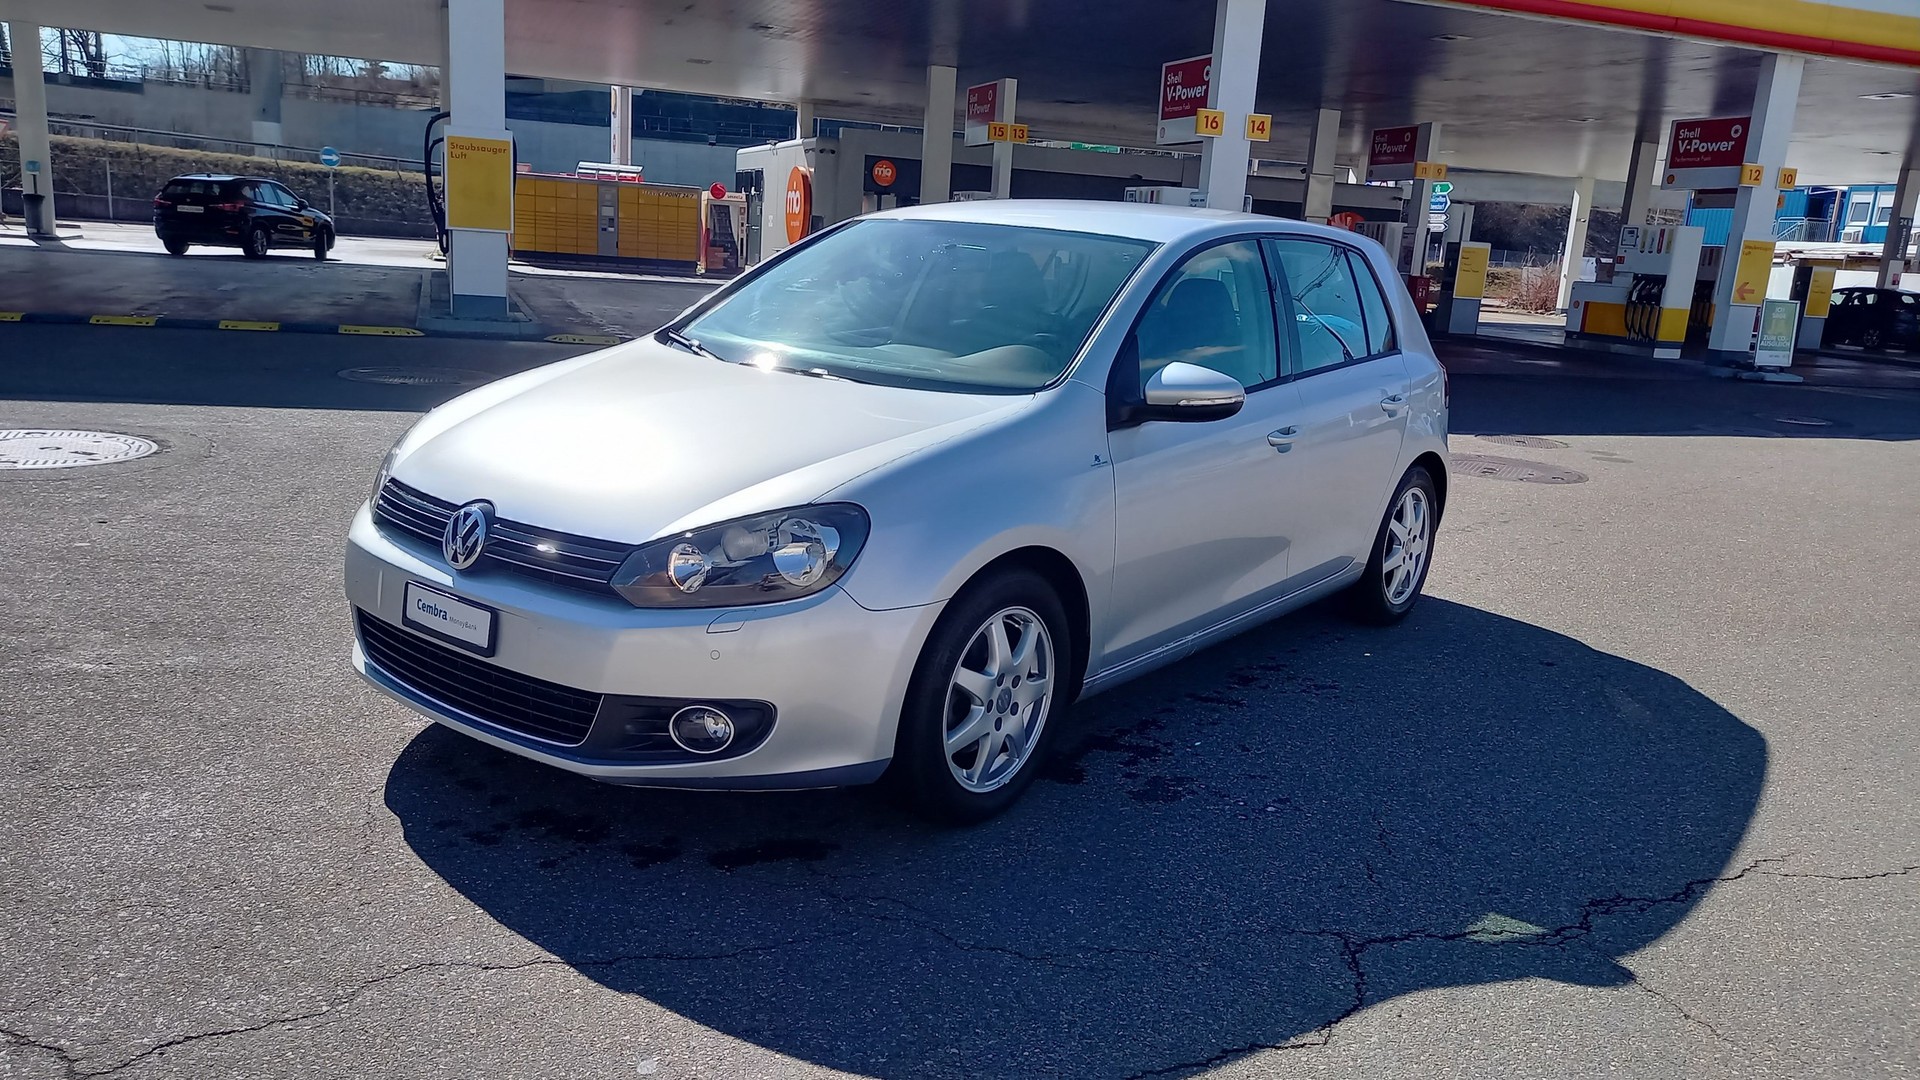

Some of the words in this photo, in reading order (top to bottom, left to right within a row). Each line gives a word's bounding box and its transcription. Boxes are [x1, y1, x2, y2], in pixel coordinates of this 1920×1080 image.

[1167, 71, 1183, 85] Shell
[1167, 84, 1207, 102] V-Power
[1204, 115, 1219, 130] 16
[1250, 120, 1266, 134] 14
[993, 126, 1005, 137] 15
[1013, 128, 1025, 139] 13
[1679, 127, 1701, 139] Shell
[450, 142, 507, 155] Staubsauger
[1374, 143, 1407, 154] V-Power
[1678, 139, 1735, 154] V-Power
[450, 151, 467, 159] Luft
[1437, 168, 1442, 176] 9
[1749, 169, 1761, 182] 12
[1782, 173, 1793, 185] 10
[416, 598, 448, 621] Cembra
